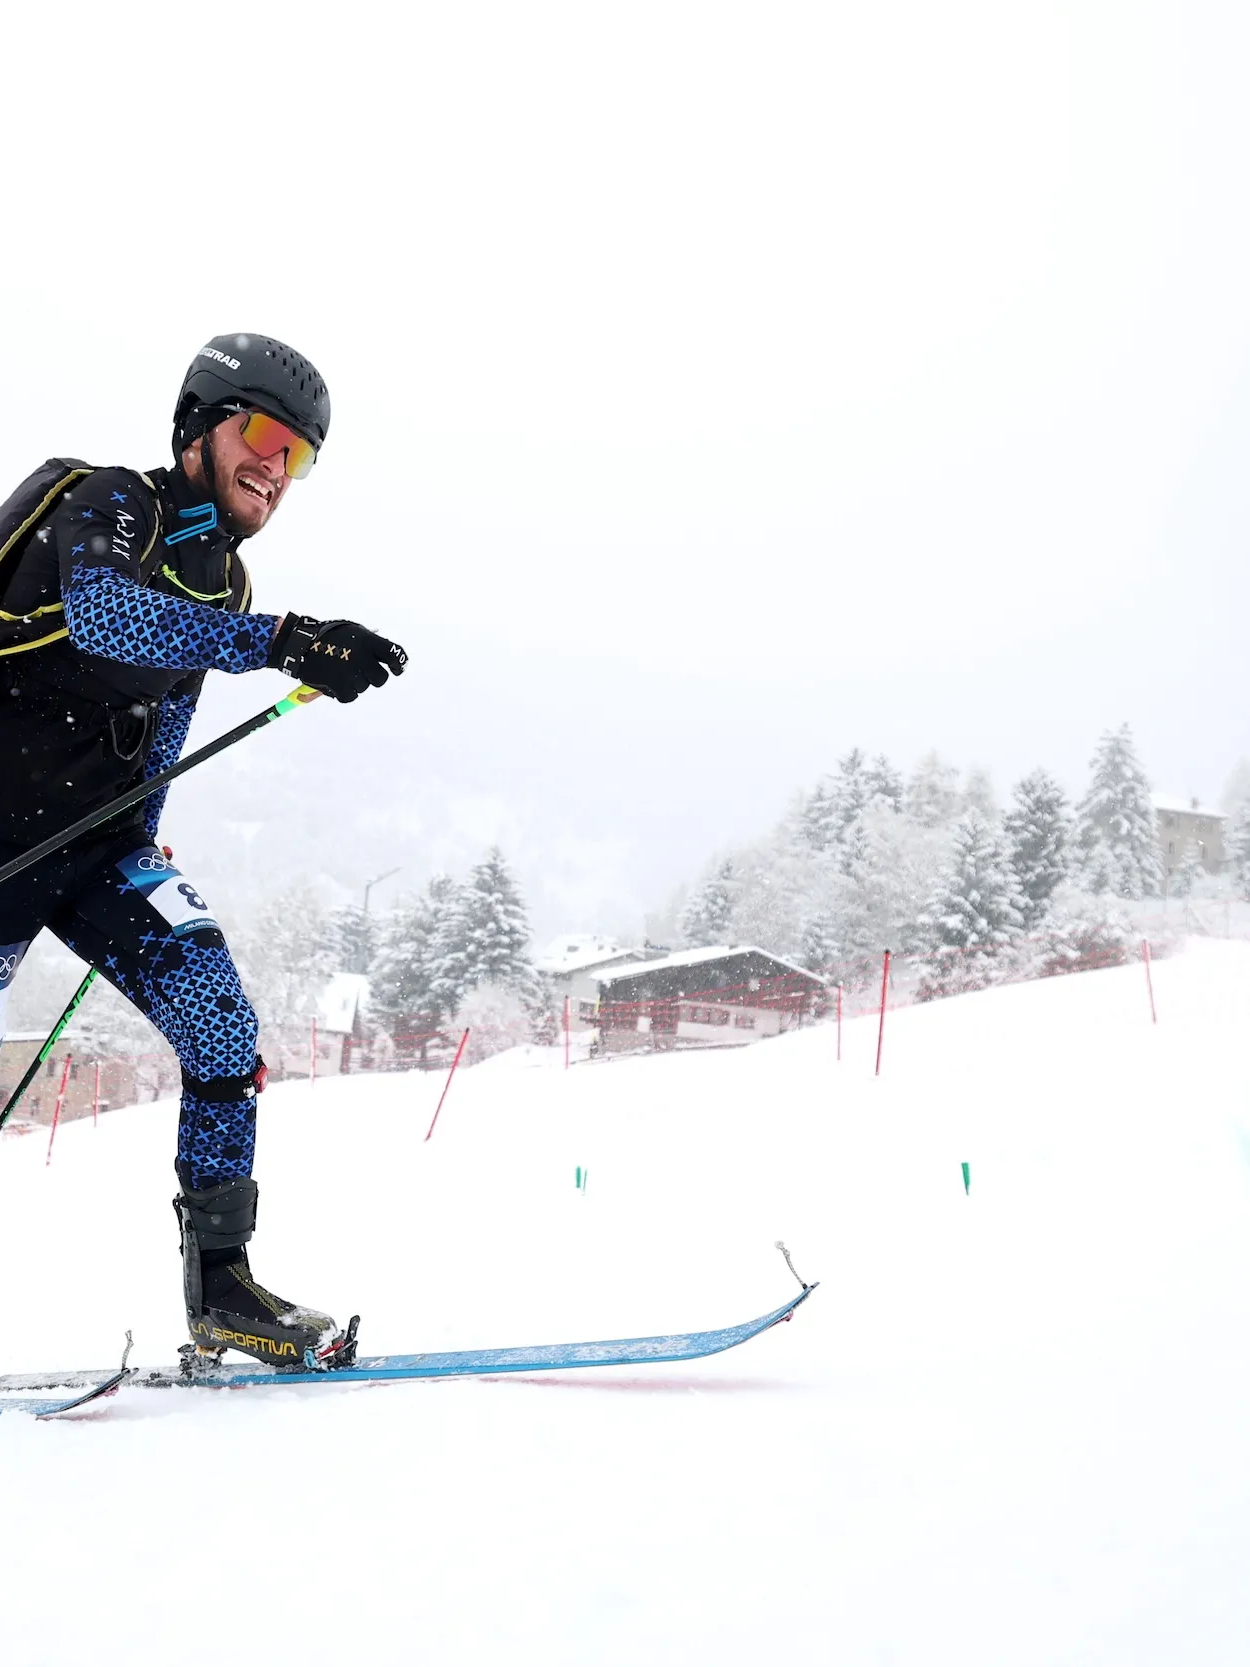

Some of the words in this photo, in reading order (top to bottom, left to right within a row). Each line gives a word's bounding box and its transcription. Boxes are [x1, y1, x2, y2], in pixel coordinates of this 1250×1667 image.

[198, 346, 241, 370] TRAB
[177, 882, 208, 911] 8
[191, 1322, 209, 1336] LA
[212, 1327, 298, 1357] SPORTIVA
